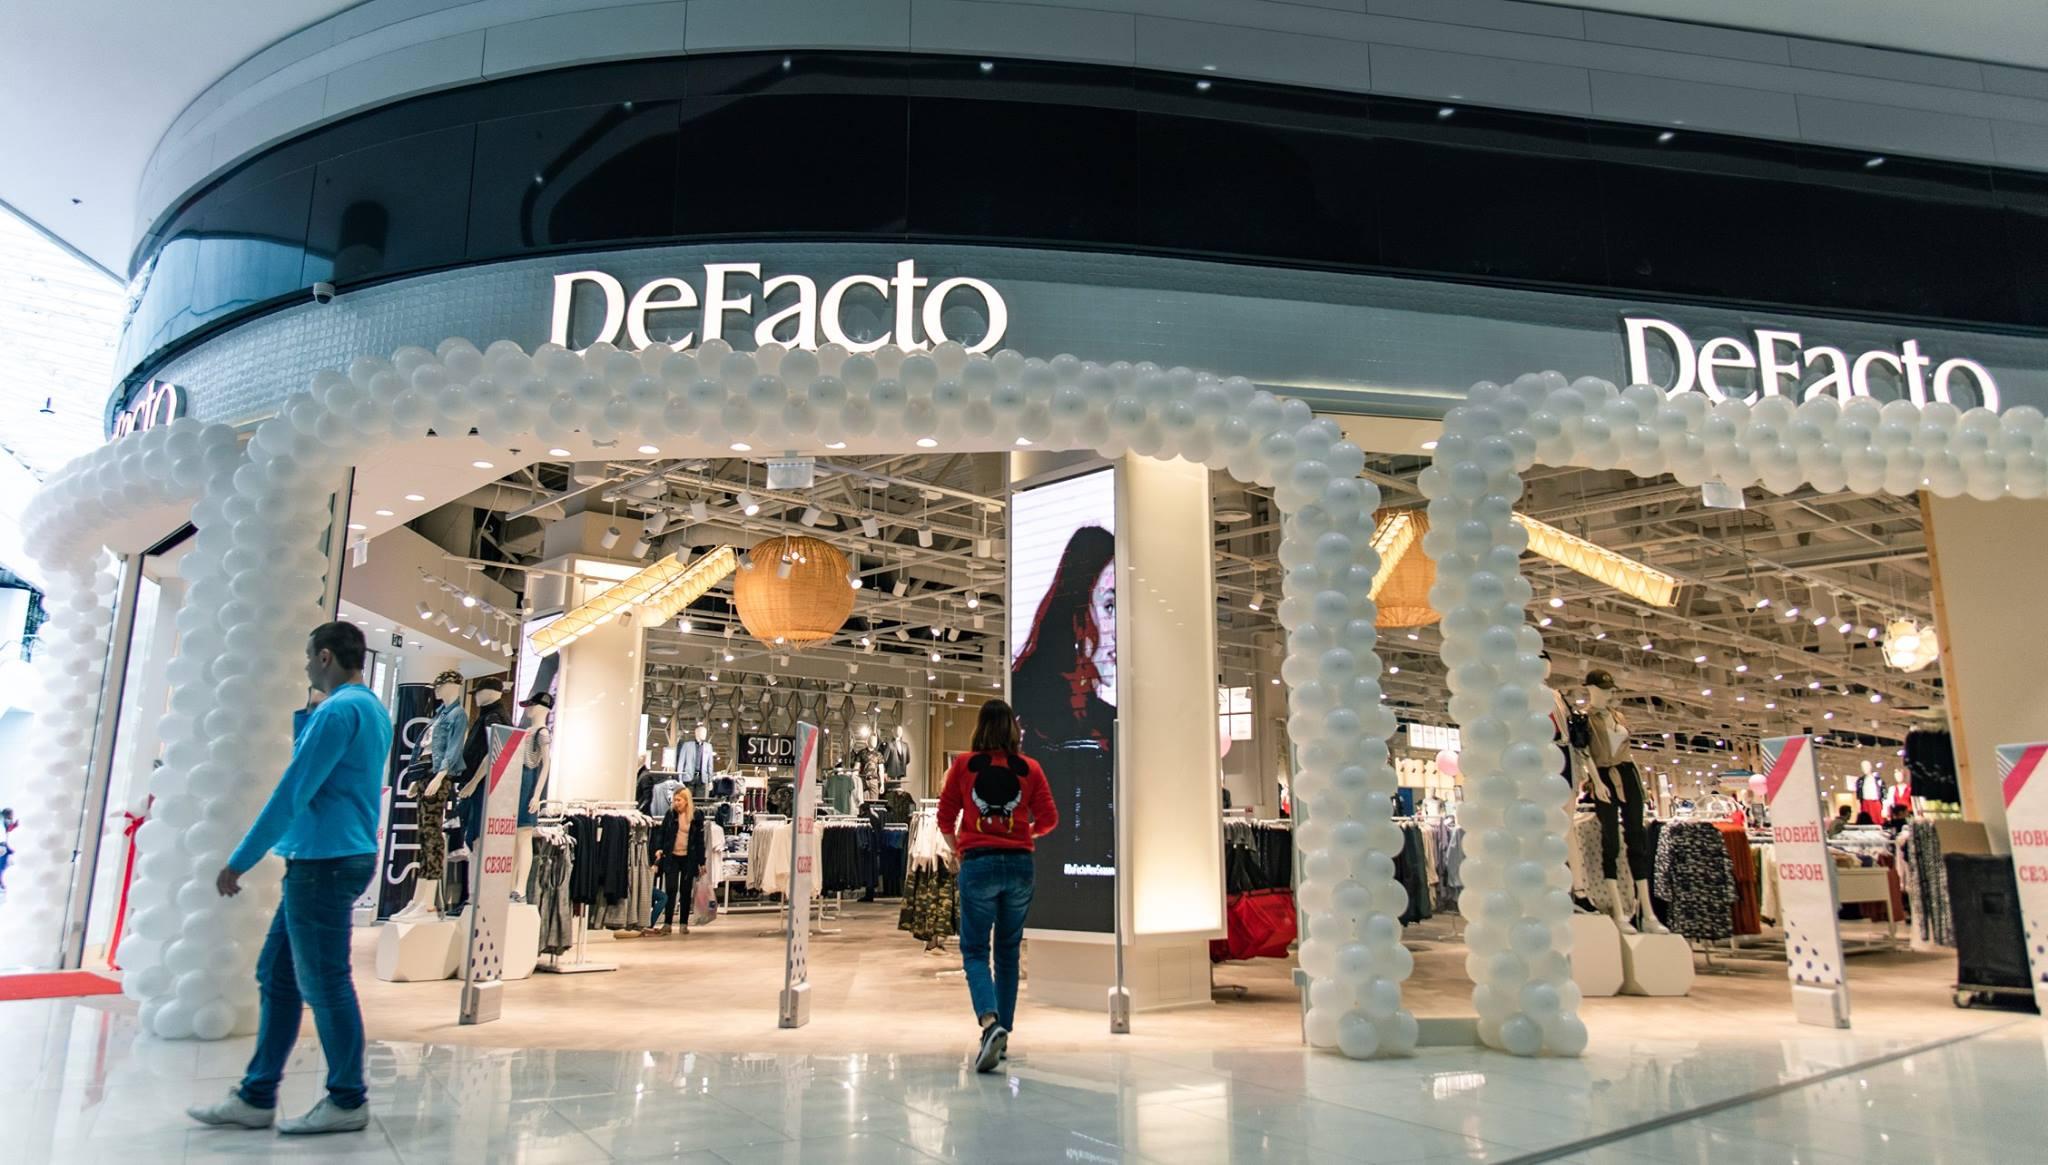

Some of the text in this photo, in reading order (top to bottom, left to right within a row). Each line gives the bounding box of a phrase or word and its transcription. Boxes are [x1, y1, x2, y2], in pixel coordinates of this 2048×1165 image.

[550, 259, 1008, 354] DeFacto
[1624, 317, 1999, 414] DeFacto
[747, 737, 795, 756] STUDI
[752, 755, 794, 765] collecti
[487, 814, 516, 835] НОВИЙ
[1774, 820, 1820, 843] НОВИЙ
[485, 856, 513, 874] СЕЗОН
[1779, 863, 1824, 881] СЕЗОН
